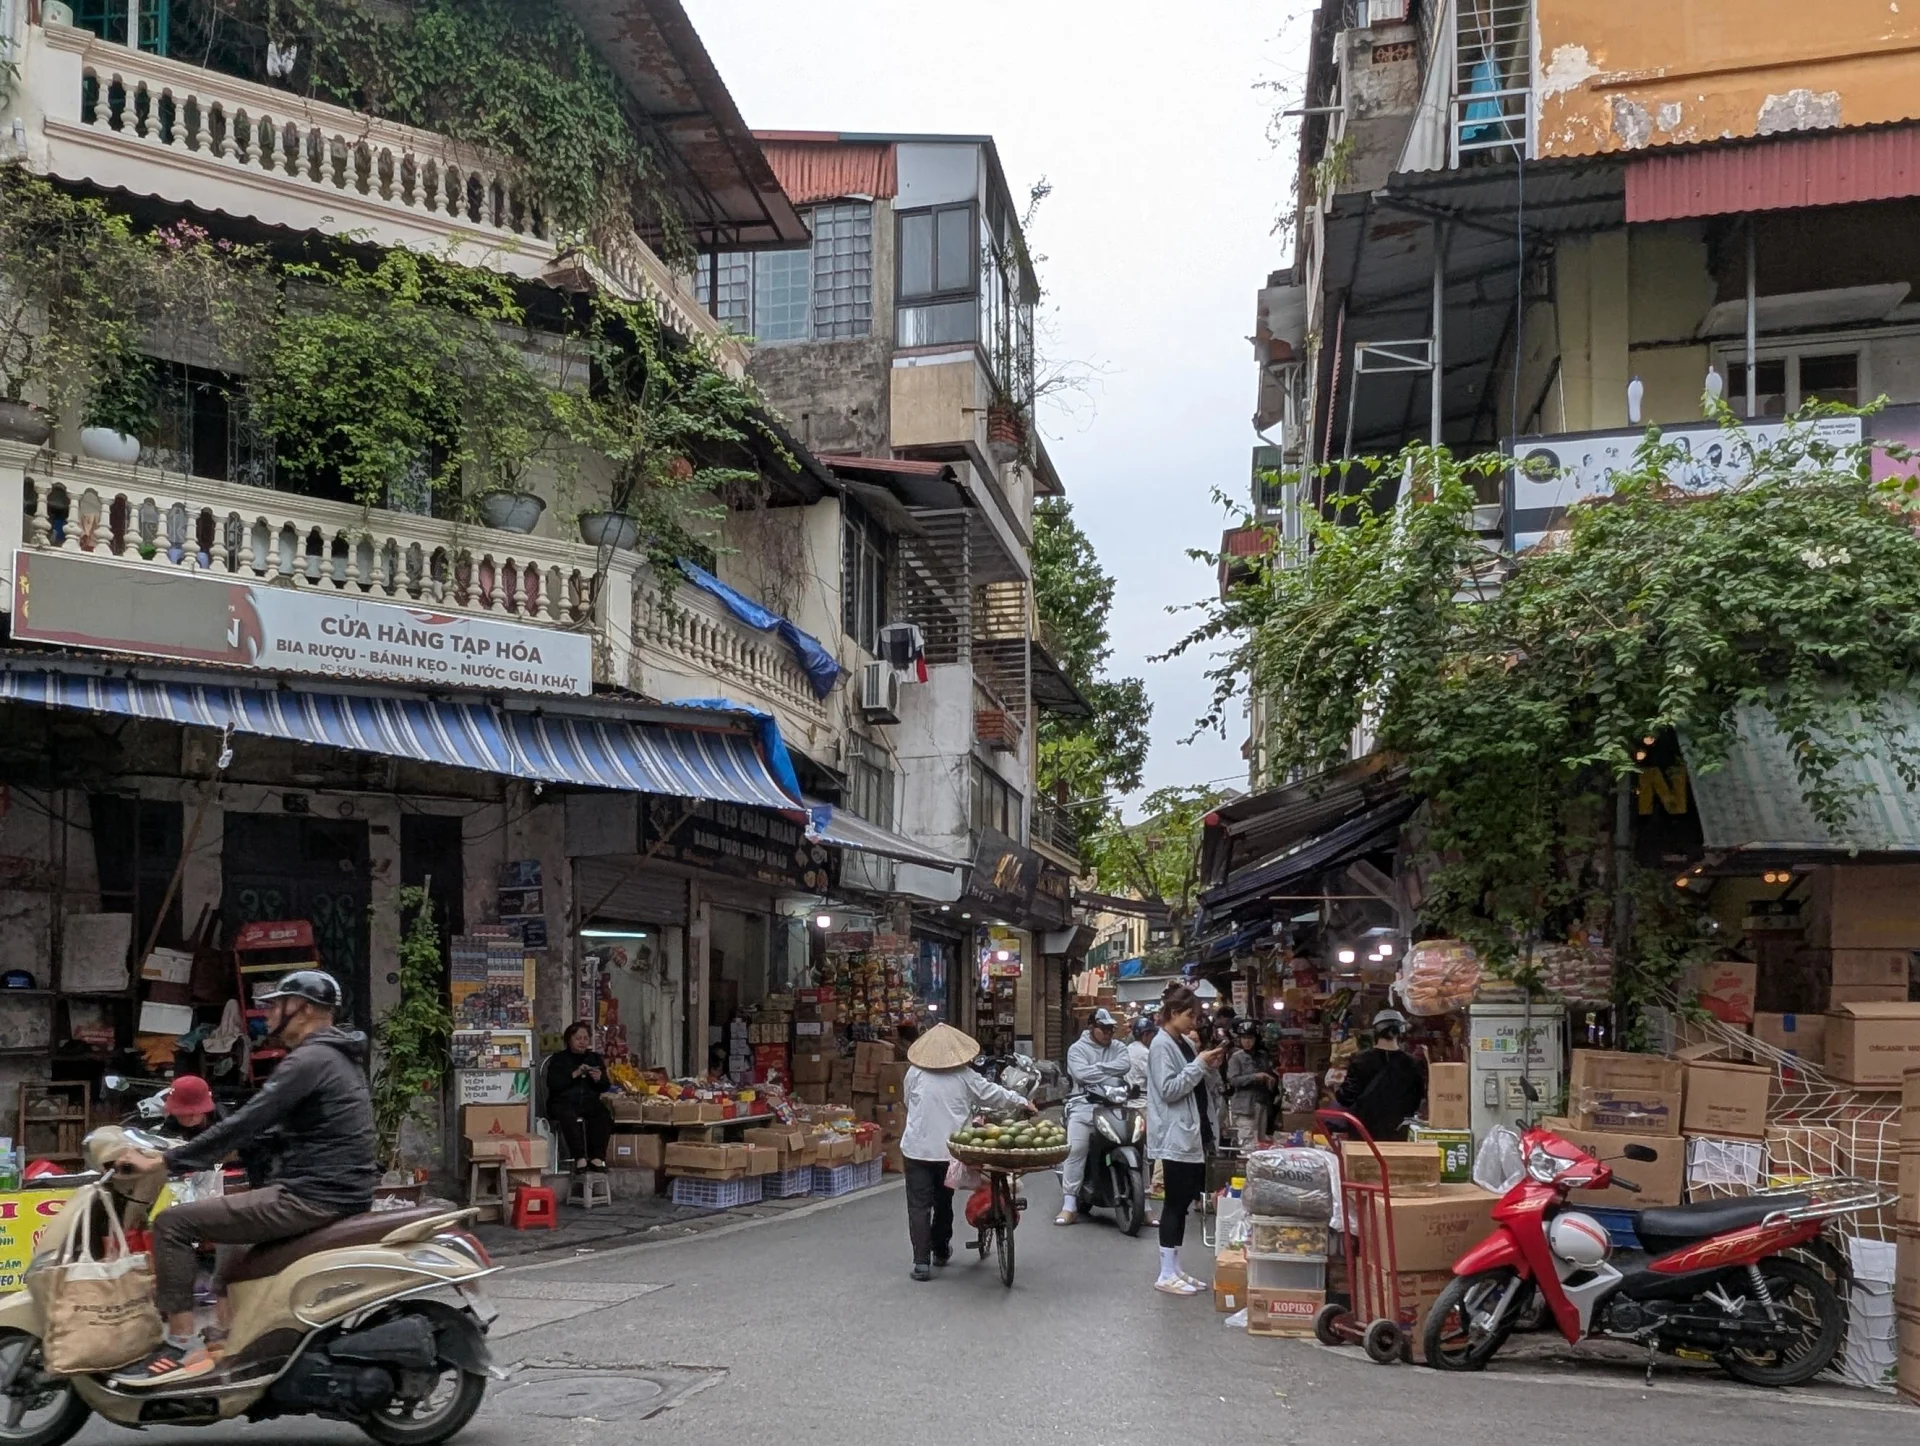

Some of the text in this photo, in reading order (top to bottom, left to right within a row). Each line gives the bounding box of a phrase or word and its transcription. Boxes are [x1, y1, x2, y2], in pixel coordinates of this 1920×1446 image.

[276, 638, 304, 654] BIA
[308, 642, 356, 662] RƯỢU
[369, 649, 413, 668] BÁNH
[417, 656, 448, 674] KẸO
[460, 663, 506, 680] NƯỚC
[509, 669, 538, 685] GIẢI
[541, 673, 578, 690] KHÁT
[320, 613, 543, 664] CỬA HÀNG TẠP HÓA
[1273, 1301, 1314, 1314] KOPIKO
